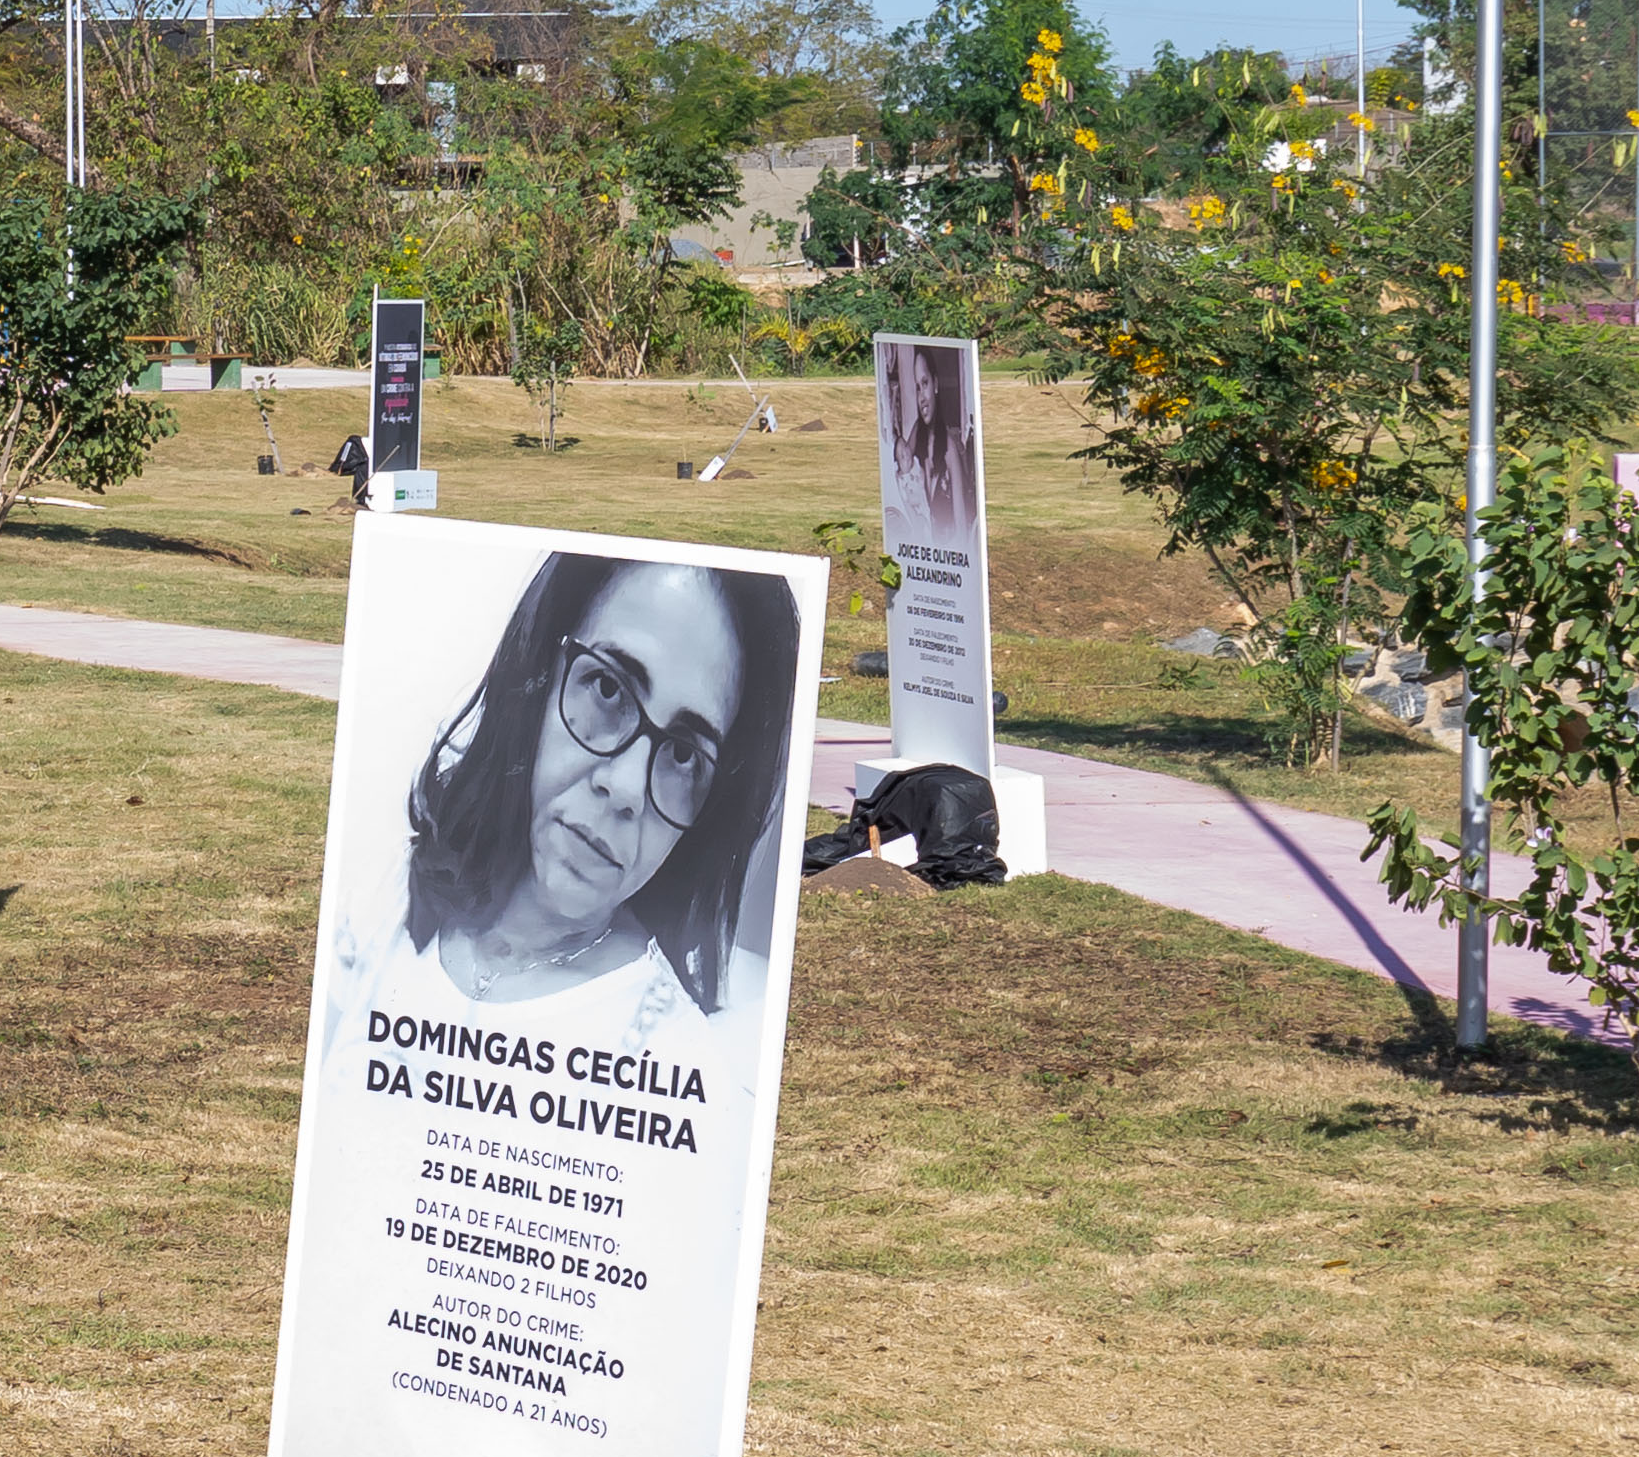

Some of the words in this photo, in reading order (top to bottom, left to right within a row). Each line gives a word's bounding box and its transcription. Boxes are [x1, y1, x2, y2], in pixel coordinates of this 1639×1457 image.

[897, 543, 919, 559] JOICE
[921, 546, 931, 561] DE
[933, 548, 970, 568] OLIVEIRA
[906, 565, 962, 588] ALEXANDRINO
[368, 1010, 555, 1074] DOMINGAS
[566, 1046, 707, 1103] CECÍLIA
[367, 1059, 413, 1099] DA
[423, 1070, 518, 1118] SILVA
[530, 1091, 698, 1154] OLIVEIRA
[427, 1129, 472, 1154] DATA
[478, 1140, 501, 1159] DE
[506, 1145, 624, 1184] NASCIMENTO:
[421, 1160, 444, 1181] 25
[450, 1166, 477, 1187] DE
[482, 1172, 542, 1202] ABRIL
[549, 1184, 577, 1209] DE
[582, 1191, 623, 1218] 1971
[386, 1217, 404, 1238] 19
[411, 1223, 437, 1245] DE
[443, 1229, 555, 1270] DEZEMBRO
[562, 1255, 589, 1279] DE
[594, 1263, 647, 1291] 2020
[416, 1198, 462, 1222] DATA
[467, 1209, 489, 1228] DE
[494, 1215, 620, 1255] FALECIMENTO:
[427, 1257, 516, 1290] DEIXANDO
[521, 1279, 530, 1294] 2
[536, 1281, 596, 1309] FILHOS
[388, 1309, 477, 1345] ALECINO
[482, 1331, 624, 1379] ANUNCIAÇÃO
[432, 1294, 492, 1321] AUTOR
[497, 1307, 522, 1327] DO
[527, 1315, 584, 1342] CRIME:
[437, 1348, 464, 1371] DE
[468, 1356, 567, 1396] SANTANA
[392, 1371, 508, 1412] (CONDENADO
[513, 1401, 525, 1417] A
[530, 1404, 546, 1421] 21
[551, 1409, 608, 1439] ANOS)
